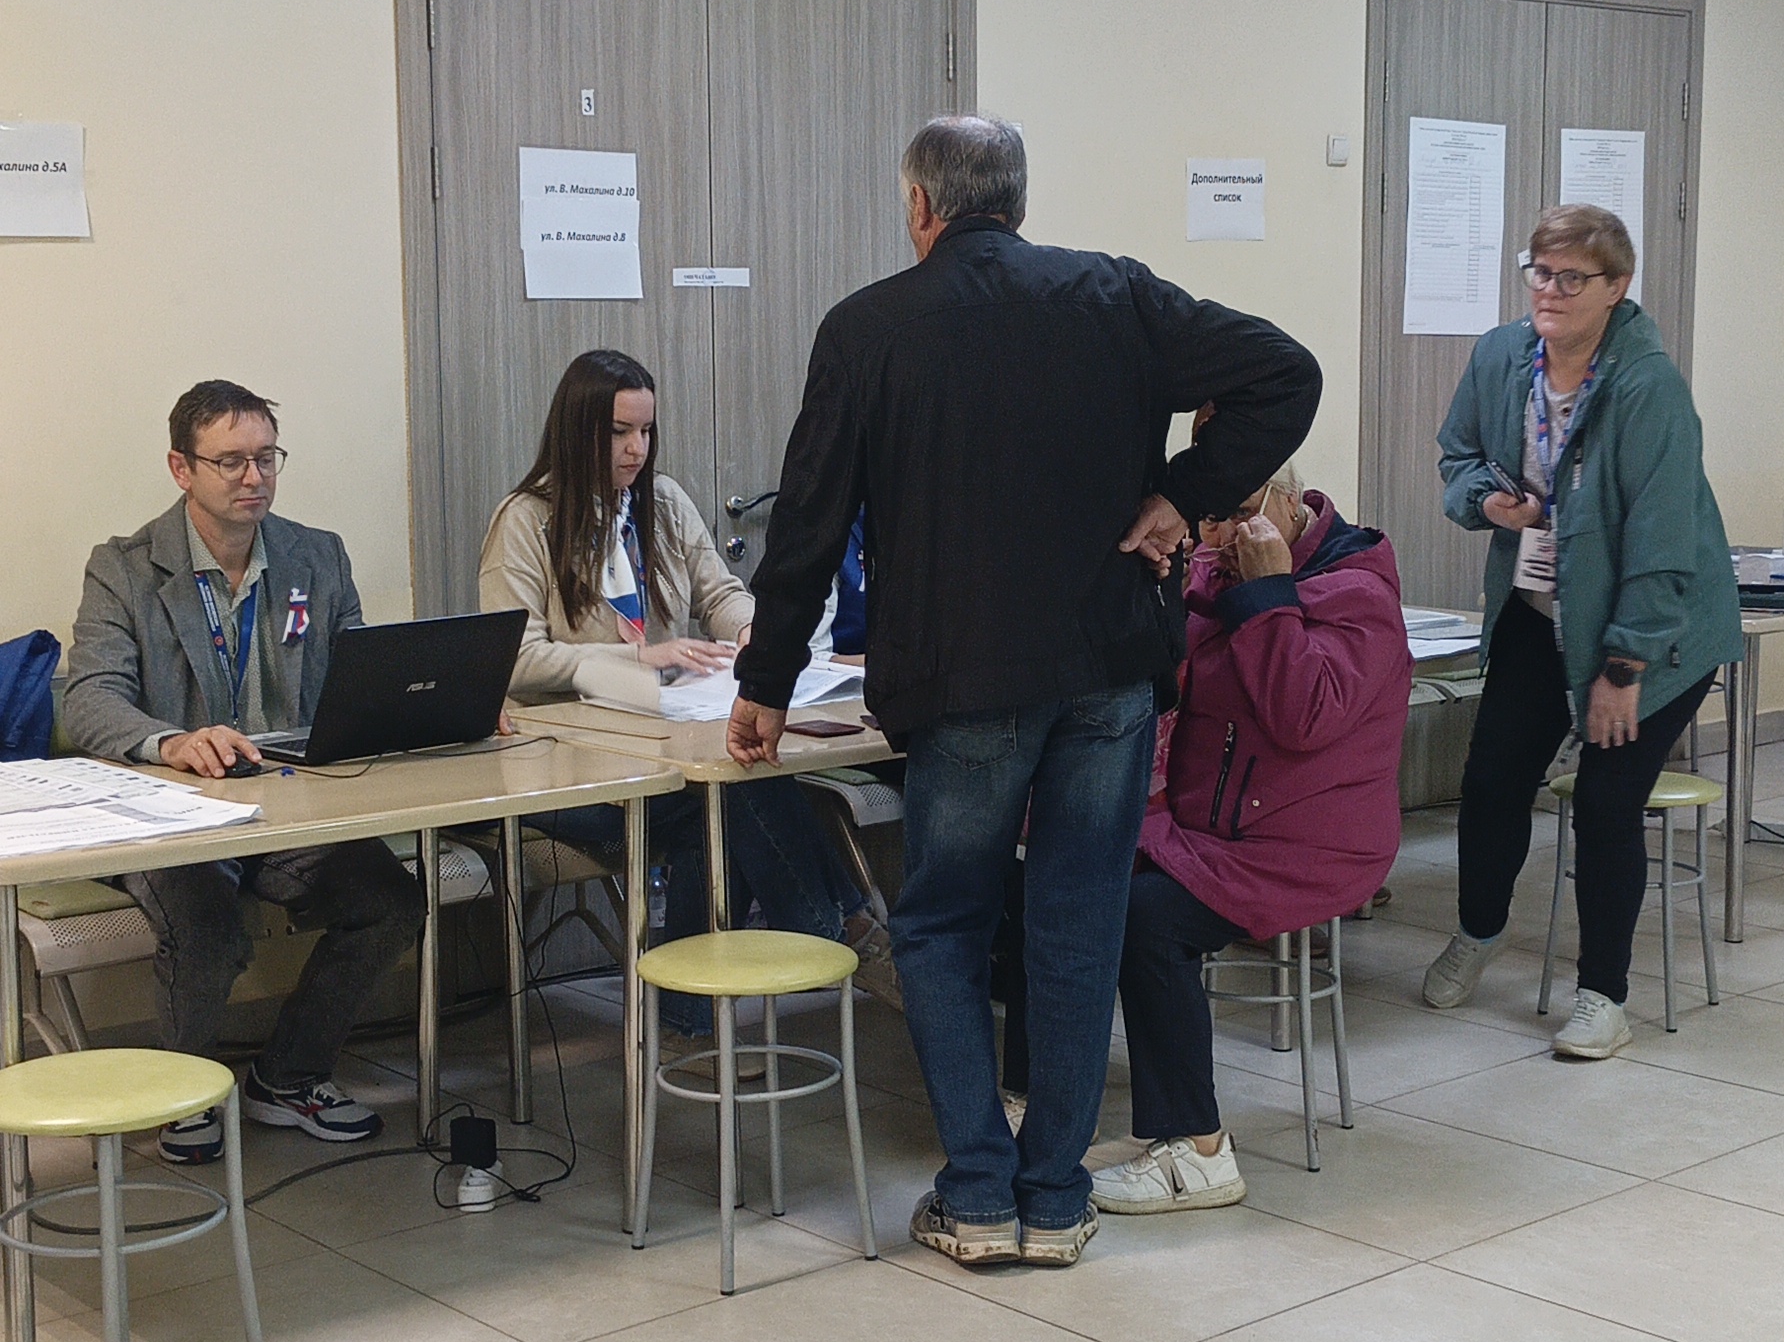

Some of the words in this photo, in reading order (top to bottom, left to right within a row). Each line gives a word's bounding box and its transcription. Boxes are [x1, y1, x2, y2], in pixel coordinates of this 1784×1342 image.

[584, 96, 592, 113] 3
[1191, 172, 1263, 186] Дополнительный
[544, 184, 558, 194] ул.
[569, 184, 615, 196] Махалина
[1213, 193, 1242, 203] список
[540, 232, 554, 242] ул.
[566, 231, 612, 242] Махалина
